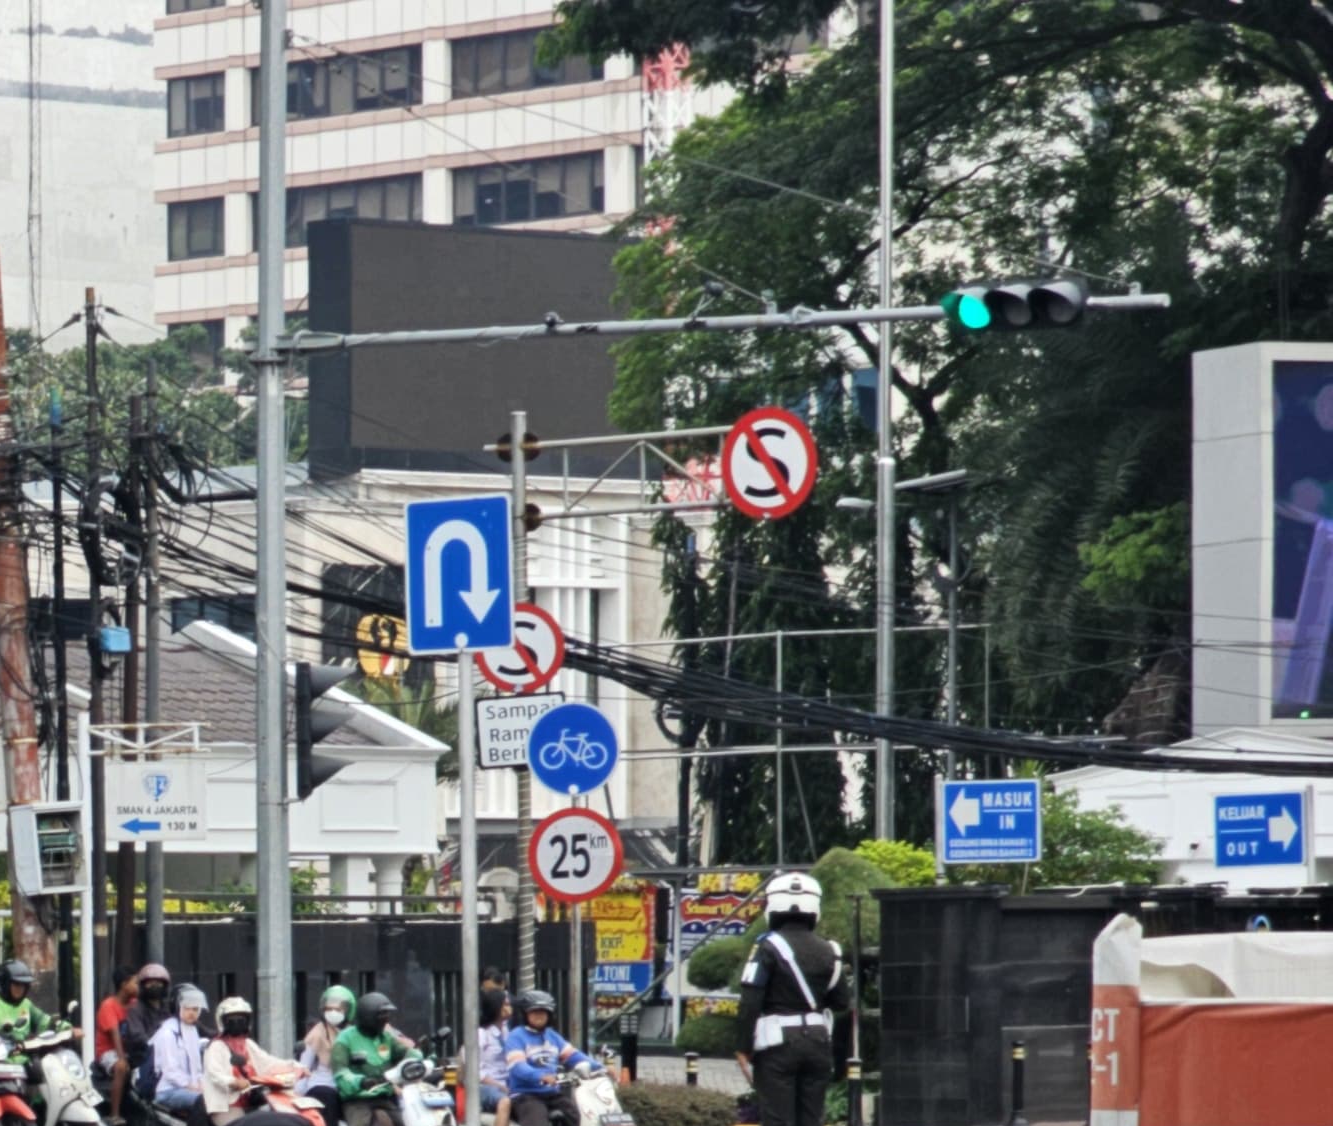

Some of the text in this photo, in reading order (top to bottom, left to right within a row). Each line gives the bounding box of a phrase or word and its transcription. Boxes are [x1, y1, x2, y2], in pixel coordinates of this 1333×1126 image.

[982, 792, 1032, 807] MASUK
[116, 805, 198, 815] SMAN 4 JAKARTA
[1218, 805, 1265, 821] KELUAR
[167, 821, 198, 831] 130 M
[999, 814, 1016, 830] IN
[549, 833, 608, 880] 25 km
[1226, 841, 1259, 857] OUT
[1087, 1051, 1118, 1085] -1
